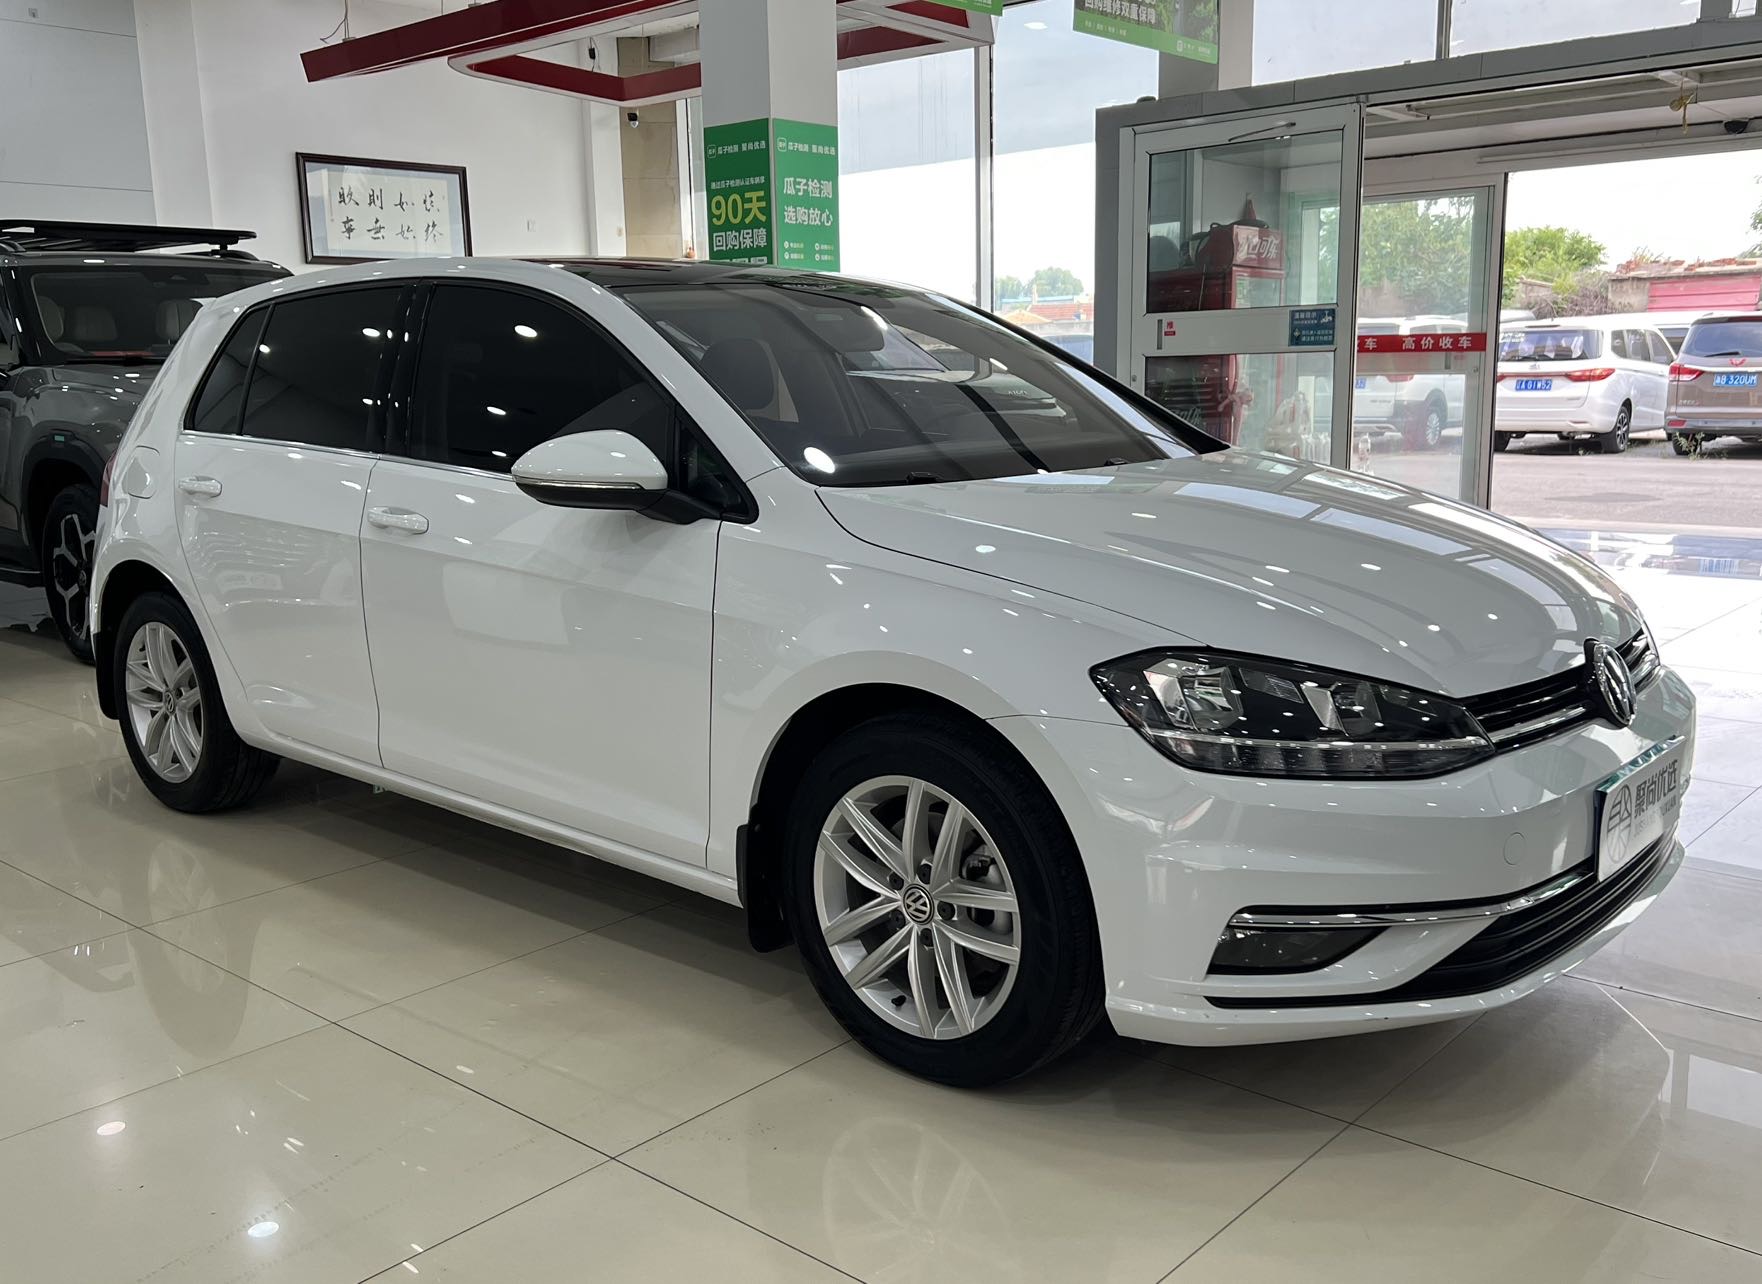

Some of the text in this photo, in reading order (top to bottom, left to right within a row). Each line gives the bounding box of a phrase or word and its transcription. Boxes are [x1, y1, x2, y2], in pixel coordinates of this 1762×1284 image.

[783, 177, 833, 199] 瓜子检测
[711, 191, 767, 226] 90天
[783, 205, 833, 227] 选购放心
[713, 228, 767, 252] 回购保障
[1402, 335, 1473, 350] 高价收车
